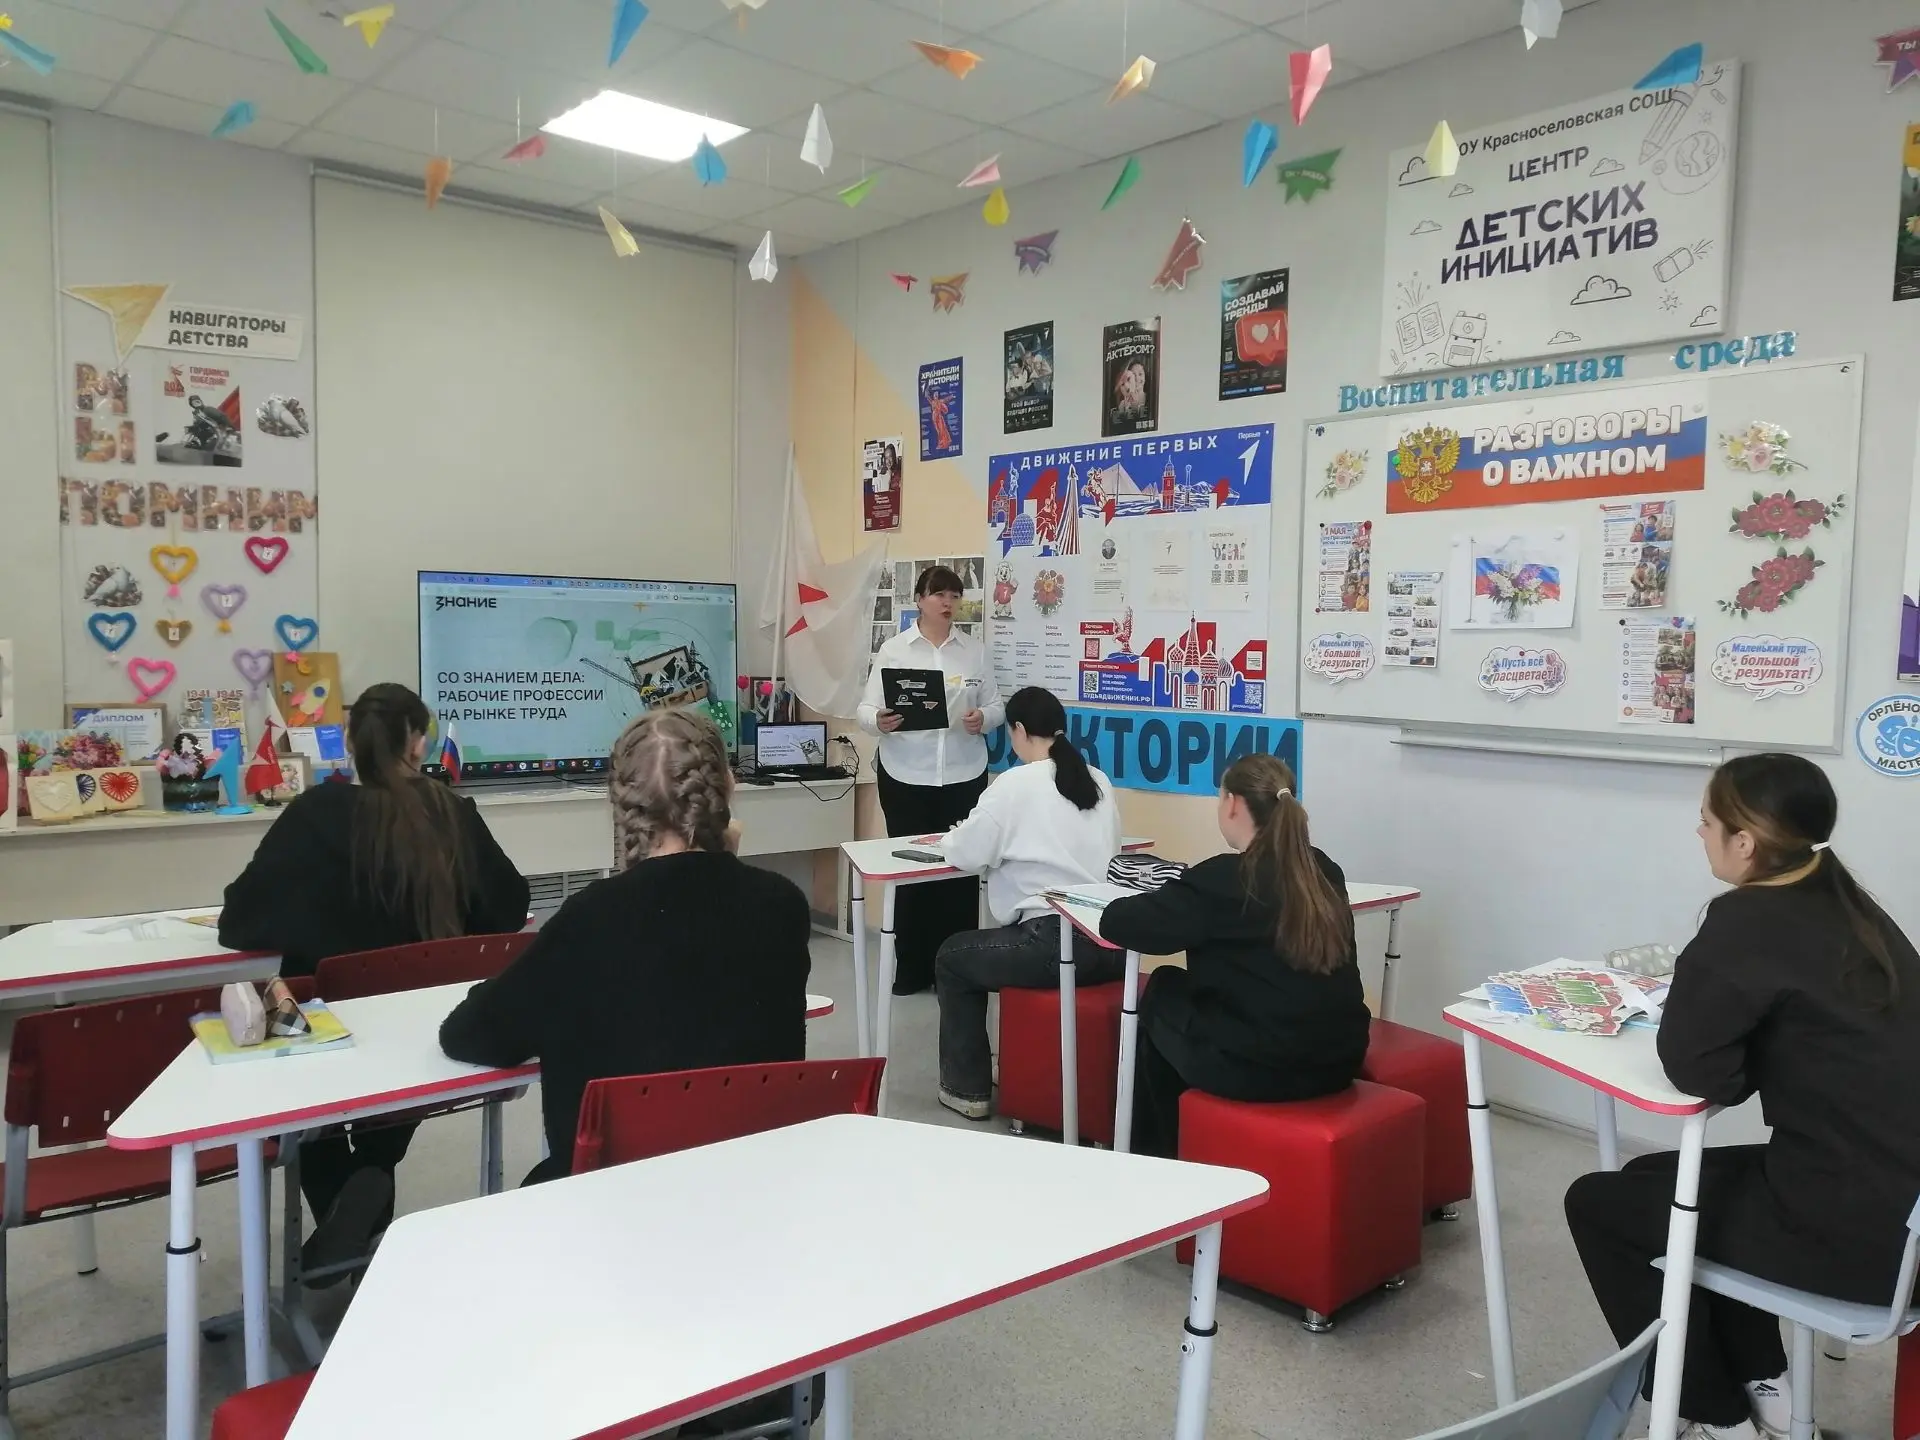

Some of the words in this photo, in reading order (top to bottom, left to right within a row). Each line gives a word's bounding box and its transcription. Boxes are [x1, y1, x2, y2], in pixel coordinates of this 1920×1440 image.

[1483, 105, 1624, 152] Красноселовская
[1630, 88, 1673, 113] СОШ
[1508, 146, 1589, 182] ЦЕНТР
[1455, 180, 1646, 250] ДЕТСКИХ
[1441, 217, 1659, 284] ИНИЦИАТИВ
[1225, 281, 1284, 311] СОЗДАВАЙ
[1224, 300, 1268, 321] ТРЕНДЫ
[169, 310, 286, 333] НАВИГАТОРЫ
[168, 329, 248, 348] ДЕТСТВА
[1108, 336, 1133, 349] ХОЧЕШЬ
[1133, 334, 1153, 343] СТАТЬ
[1106, 344, 1156, 362] АКТЁРОМ?
[921, 365, 960, 380] ХРАНИТЕЛИ
[928, 373, 960, 386] ИСТОРИИ
[1338, 354, 1625, 413] Воспитательная
[1673, 331, 1799, 372] среда
[1238, 431, 1261, 440] Первые
[1474, 404, 1682, 454] РАЗГОВОРЫ
[1020, 446, 1122, 471] ДВИЖЕНИЕ
[1132, 435, 1219, 457] ПЕРВЫХ
[1482, 459, 1504, 487] О
[1509, 444, 1667, 485] ВАЖНОМ
[1351, 640, 1364, 649] труд
[1731, 643, 1784, 653] Маленький
[1787, 645, 1807, 655] труд
[1323, 648, 1361, 658] большой
[1740, 654, 1800, 666] большой
[1319, 658, 1370, 669] результат!
[1501, 657, 1526, 670] Пусть
[1527, 656, 1544, 667] всё
[437, 672, 459, 684] СО
[463, 672, 538, 684] ЗНАНИЕМ
[541, 672, 585, 685] ДЕЛА:
[1493, 667, 1557, 684] расцветает!
[1735, 667, 1813, 680] результат!
[186, 690, 211, 698] 1941
[216, 689, 244, 698] 1945
[438, 690, 509, 702] РАБОЧИЕ
[513, 689, 604, 702] ПРОФЕССИИ
[92, 714, 144, 723] ДИПЛОМ
[438, 708, 460, 721] НА
[463, 708, 516, 720] РЫНКЕ
[520, 708, 568, 720] ТРУДА
